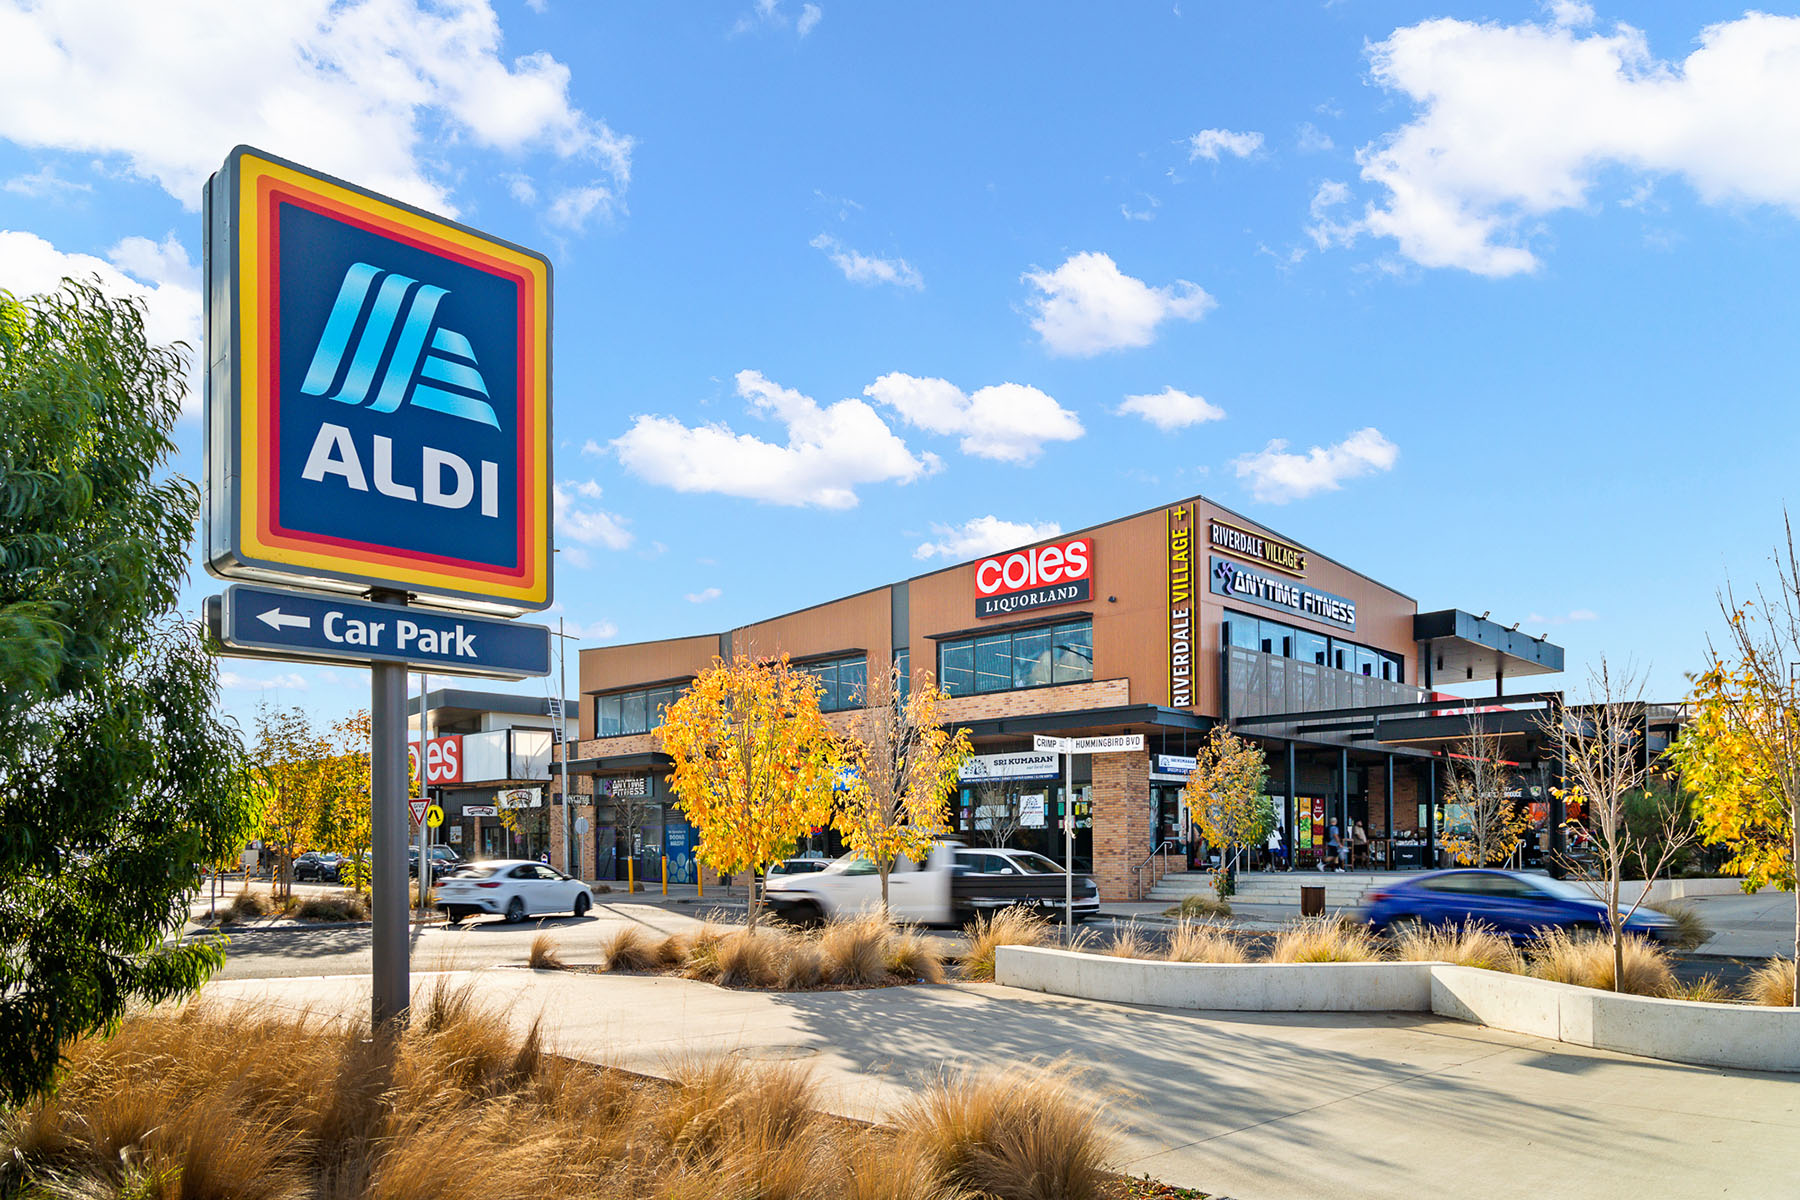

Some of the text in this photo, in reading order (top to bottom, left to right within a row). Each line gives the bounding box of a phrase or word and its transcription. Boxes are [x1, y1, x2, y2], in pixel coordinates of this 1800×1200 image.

[301, 422, 498, 518] ALDI
[976, 541, 1088, 594] coles
[1172, 526, 1189, 604] VILLAGE
[1212, 524, 1264, 558] RIVERDALE
[1264, 541, 1299, 570] VILLAGE
[985, 586, 1079, 612] LIQUORLAND
[1234, 571, 1356, 625] ANYTIME FITNESS
[322, 611, 478, 658] Car Park
[1172, 607, 1190, 708] RIVERDALE
[1008, 756, 1054, 765] KUMARAN
[1036, 737, 1057, 748] CRIMP
[1075, 738, 1124, 749] HUMMINGBIRD
[1125, 736, 1141, 746] BVD
[612, 778, 645, 788] ANYTIME
